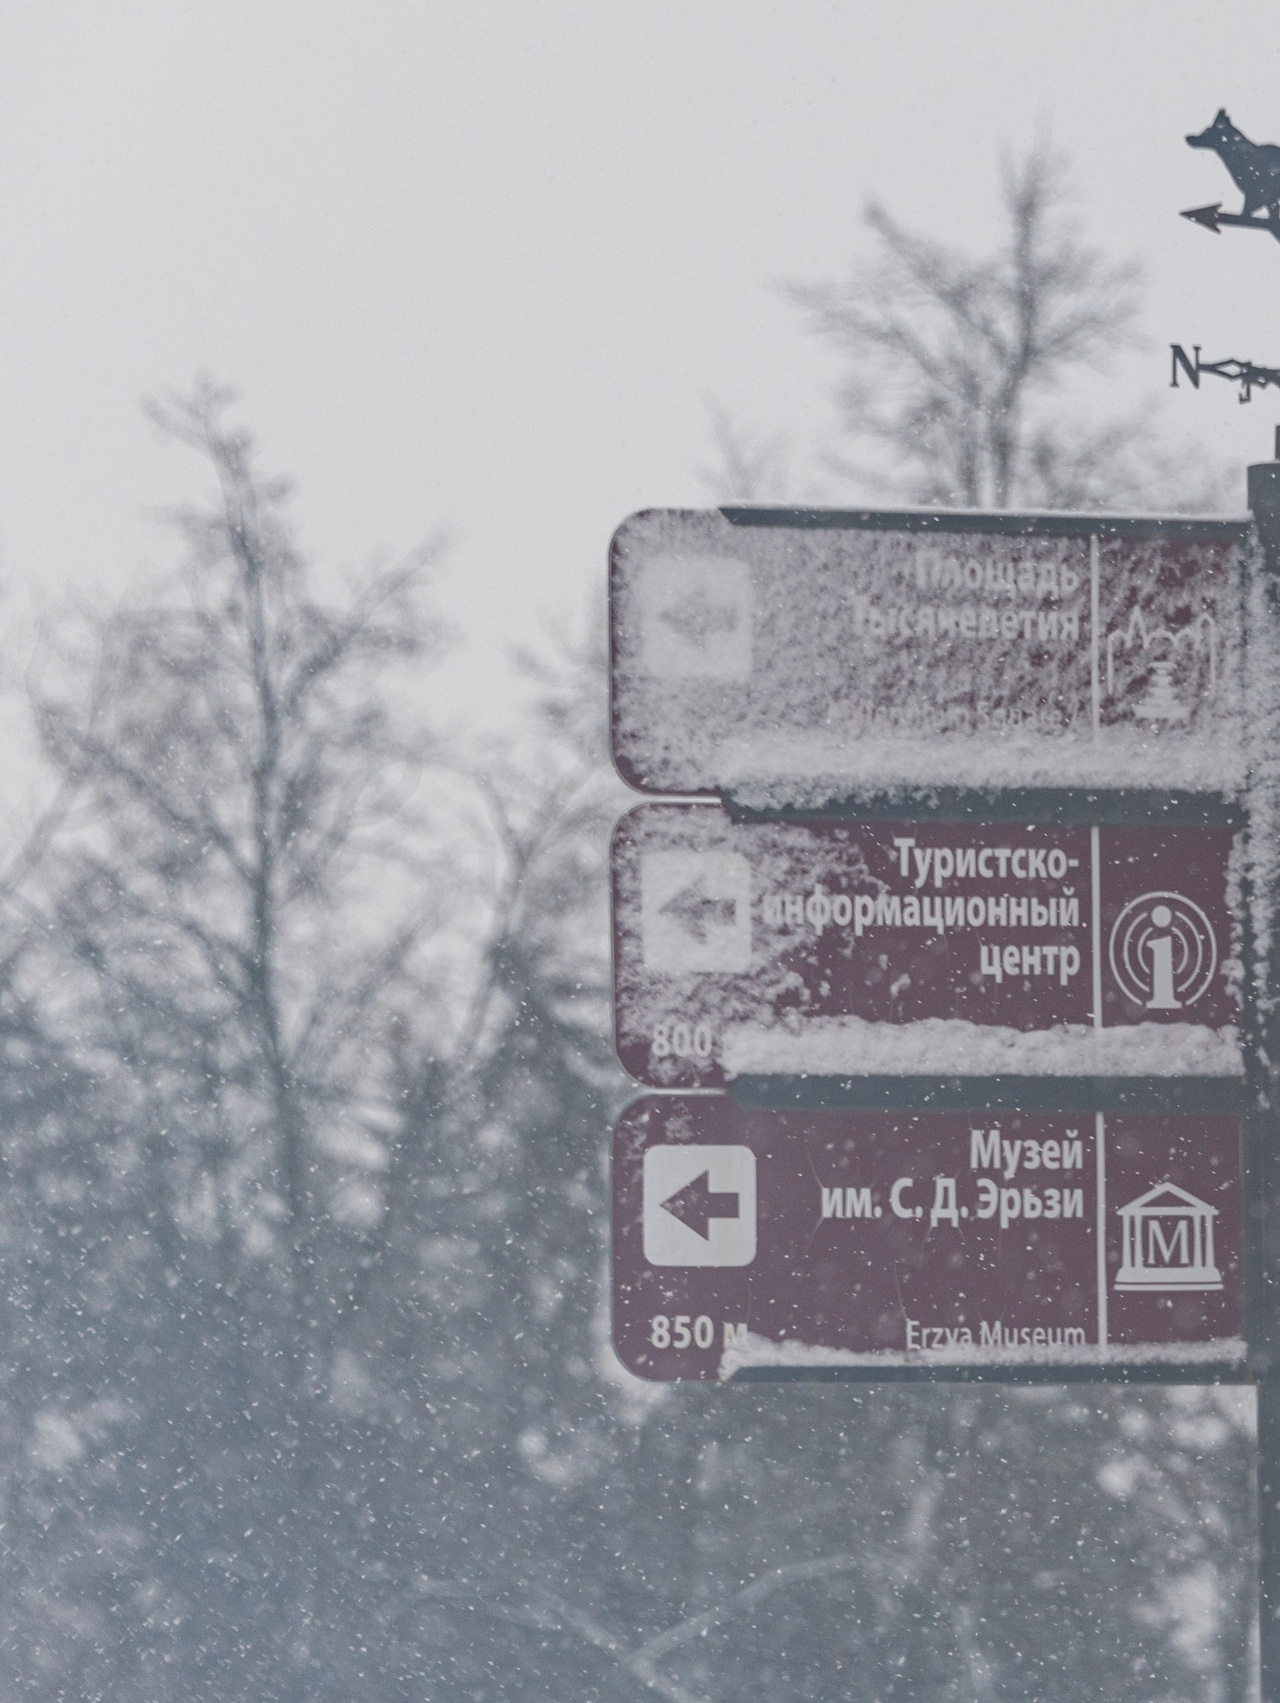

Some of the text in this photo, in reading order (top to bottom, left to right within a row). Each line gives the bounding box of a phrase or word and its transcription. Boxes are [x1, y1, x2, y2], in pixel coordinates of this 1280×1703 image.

[915, 551, 1079, 597] Площадь
[894, 836, 1079, 888] Туристско-
[764, 887, 1080, 937] информационный
[979, 943, 1081, 985] центр
[650, 1024, 713, 1059] 800
[969, 1128, 1085, 1181] Музей
[821, 1176, 1085, 1229] им. С. Д. Эрьзи
[651, 1314, 750, 1352] 850 м
[979, 1319, 1087, 1350] Museum
